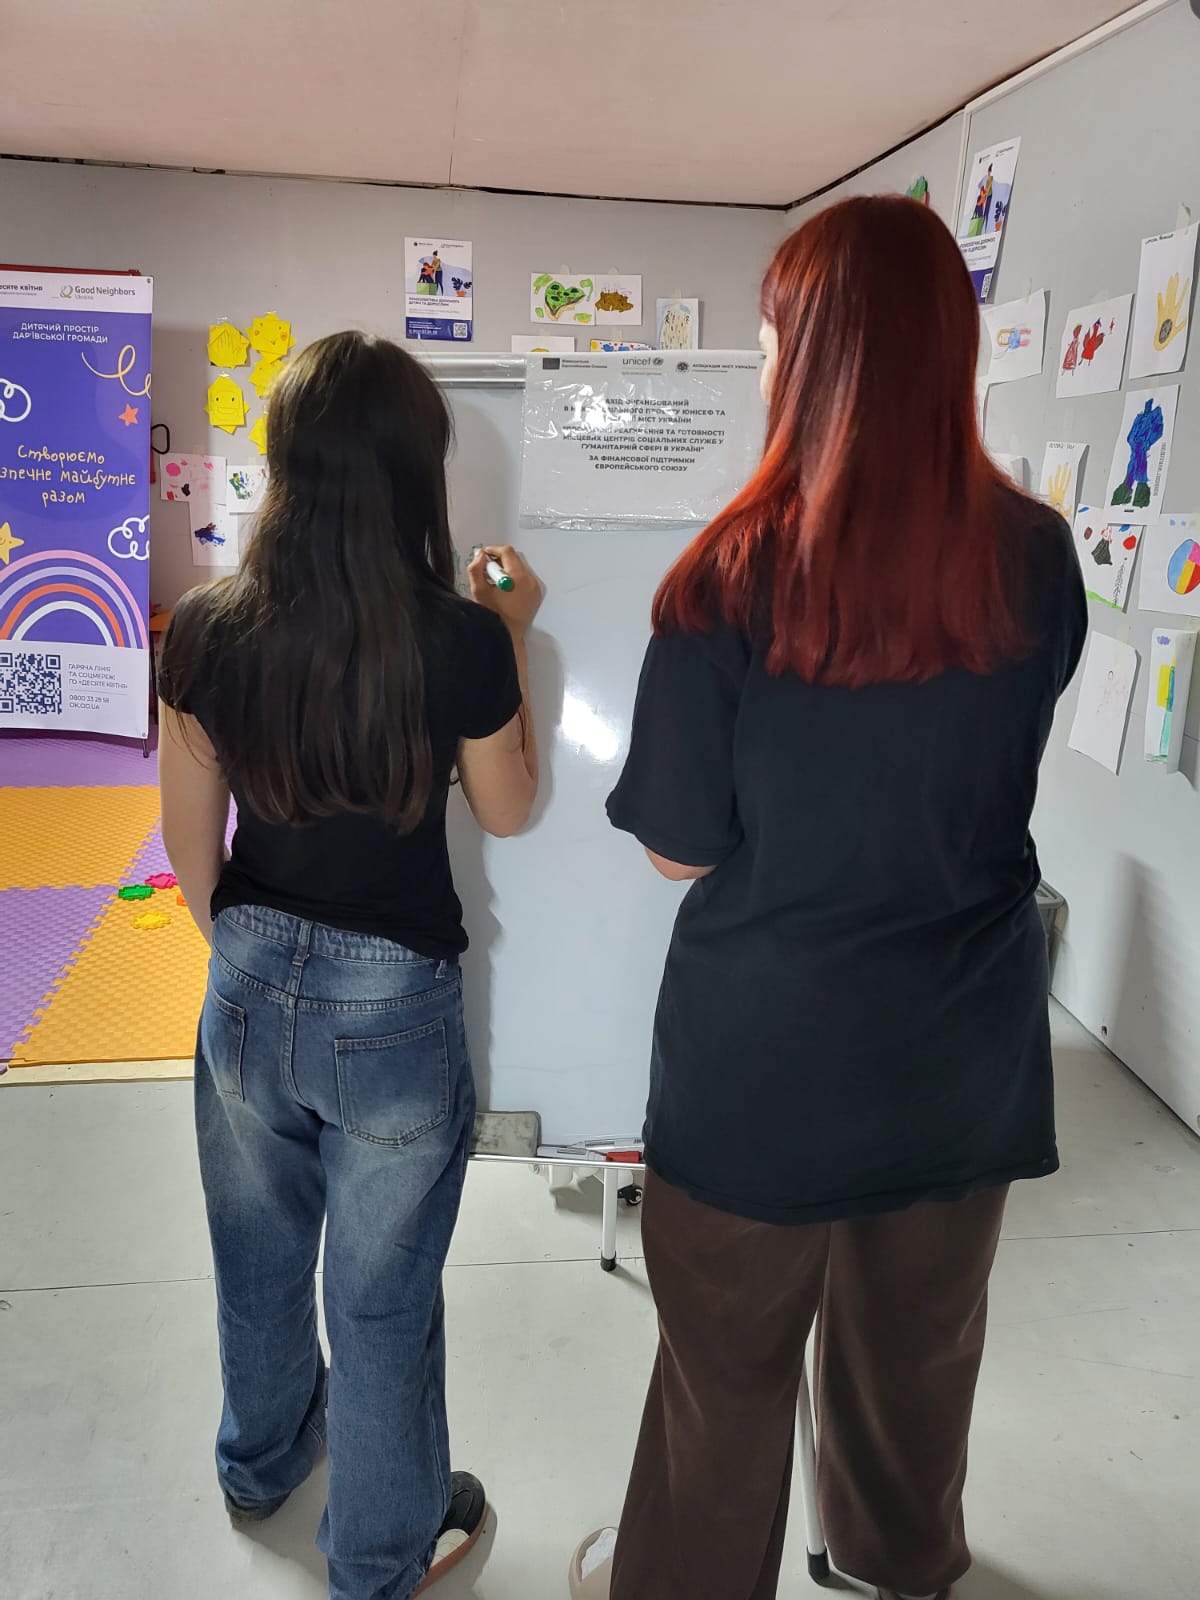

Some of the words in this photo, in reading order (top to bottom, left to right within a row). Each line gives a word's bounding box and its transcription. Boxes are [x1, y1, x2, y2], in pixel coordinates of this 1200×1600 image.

[75, 286, 95, 295] Good
[96, 286, 136, 297] Neighbors
[20, 322, 61, 332] ДИТЯЧИЙ
[63, 324, 99, 333] ПРОСТІР
[67, 334, 109, 344] ГРОМАДИ
[622, 356, 651, 366] unicef
[658, 416, 692, 424] УКРАЇНИ
[604, 435, 635, 443] ЦЕНТРІВ
[637, 436, 687, 444] СОЦІАЛЬНИХ
[581, 443, 638, 451] ГУМАНІТАРНІЙ
[639, 444, 662, 452] СФЕРІ
[18, 445, 105, 468] Створюємо
[600, 455, 649, 463] ФІНАНСОВОЇ
[650, 456, 696, 464] ПІДТРИМКИ
[595, 462, 660, 471] ЄВРОПЕЙСЬКОГО
[660, 464, 689, 472] СОЮЗУ
[41, 490, 86, 508] разом
